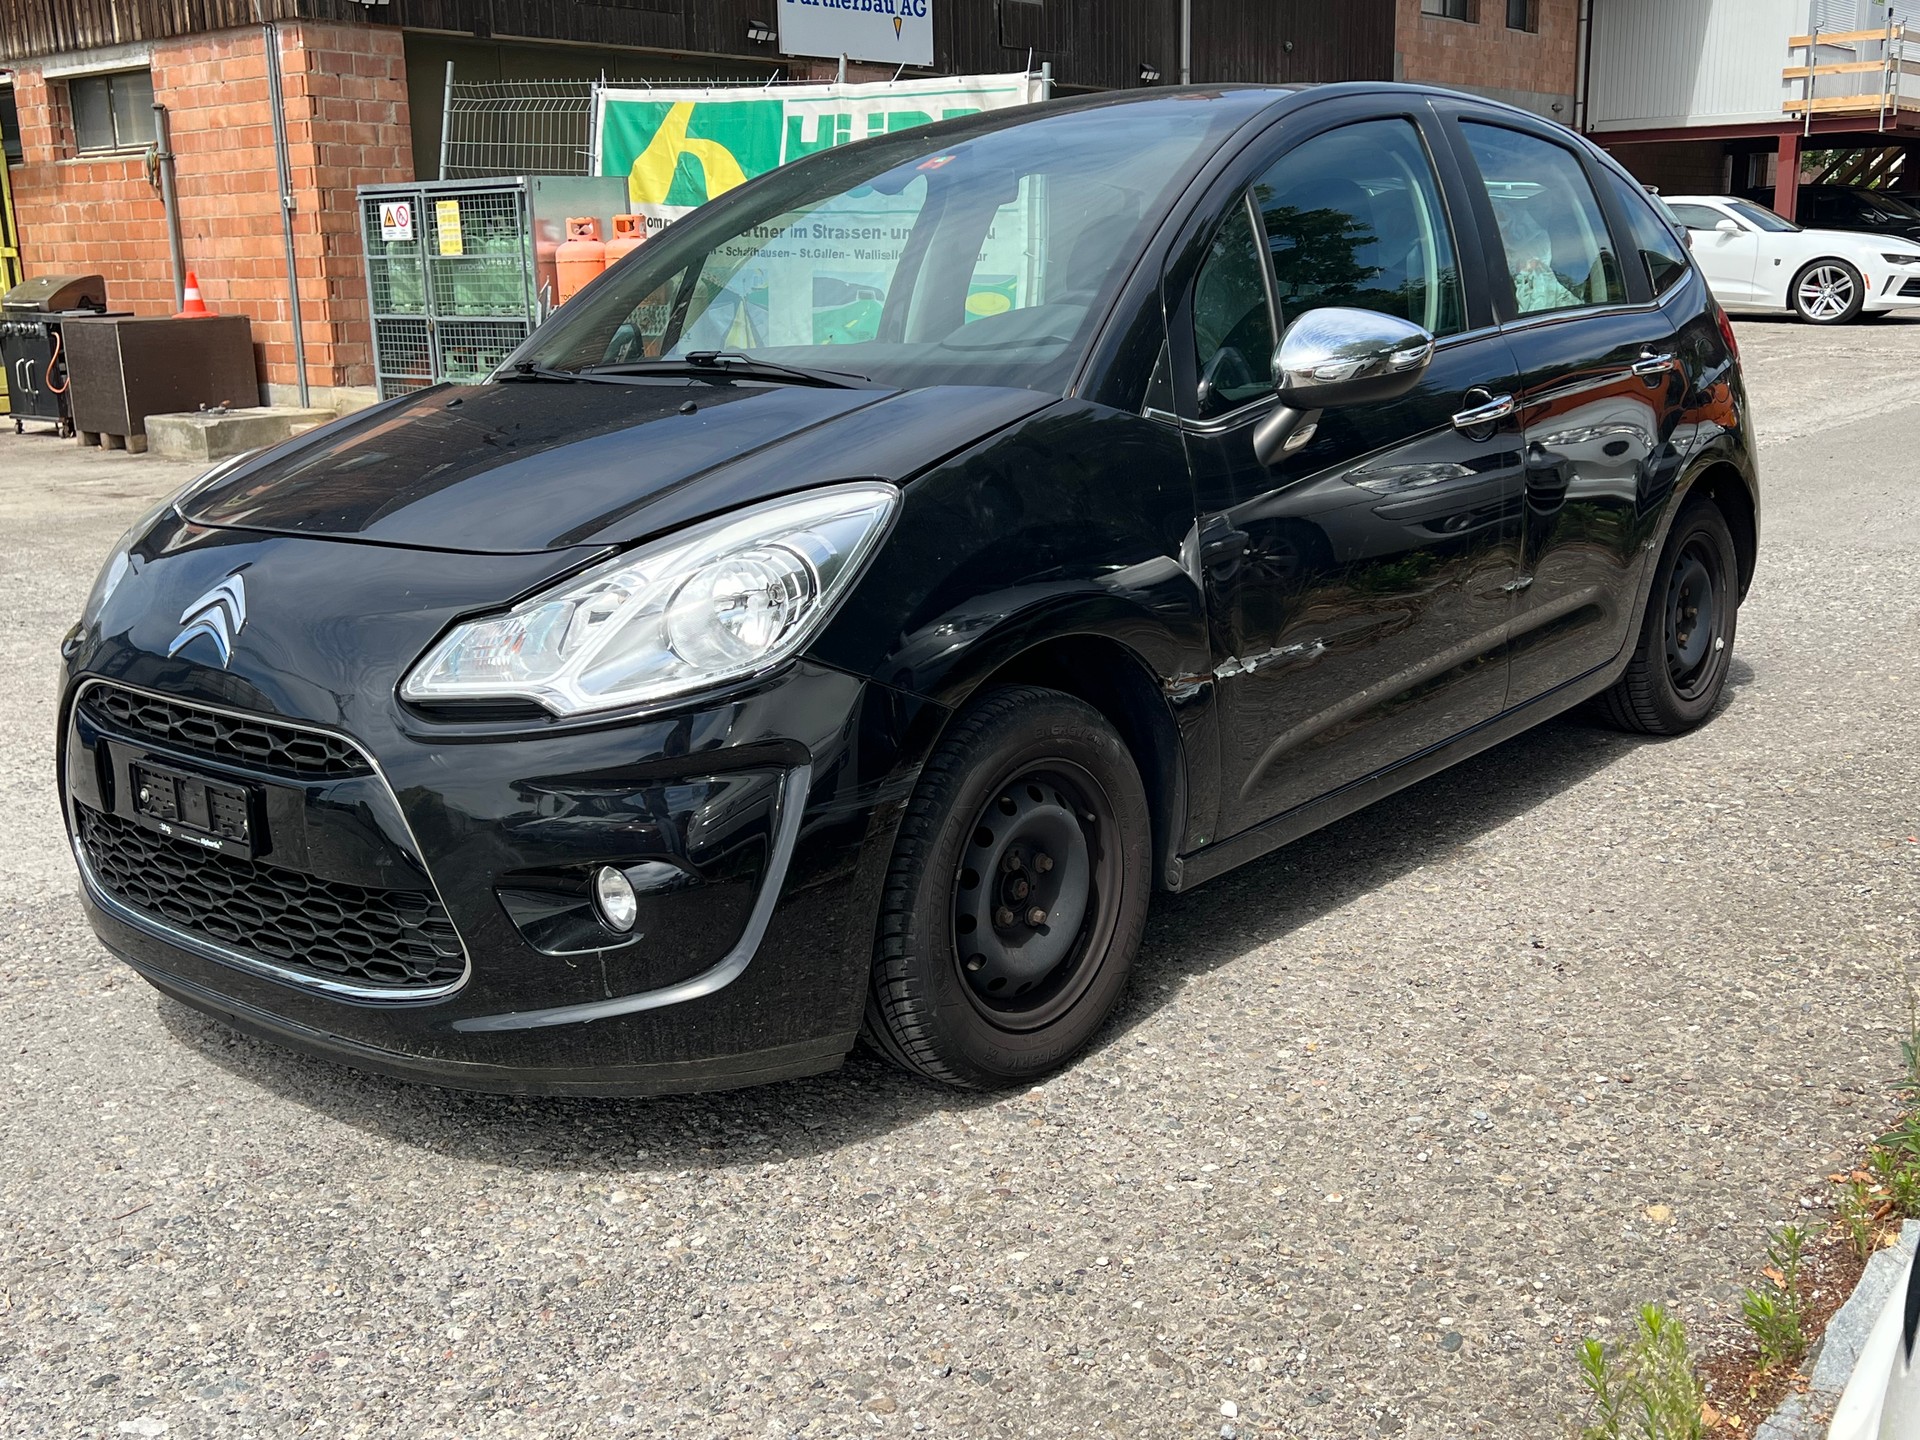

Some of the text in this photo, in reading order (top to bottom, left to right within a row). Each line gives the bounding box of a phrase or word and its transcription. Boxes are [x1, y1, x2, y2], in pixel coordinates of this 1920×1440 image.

[900, 0, 927, 17] AG
[790, 224, 808, 239] im
[890, 227, 912, 240] un
